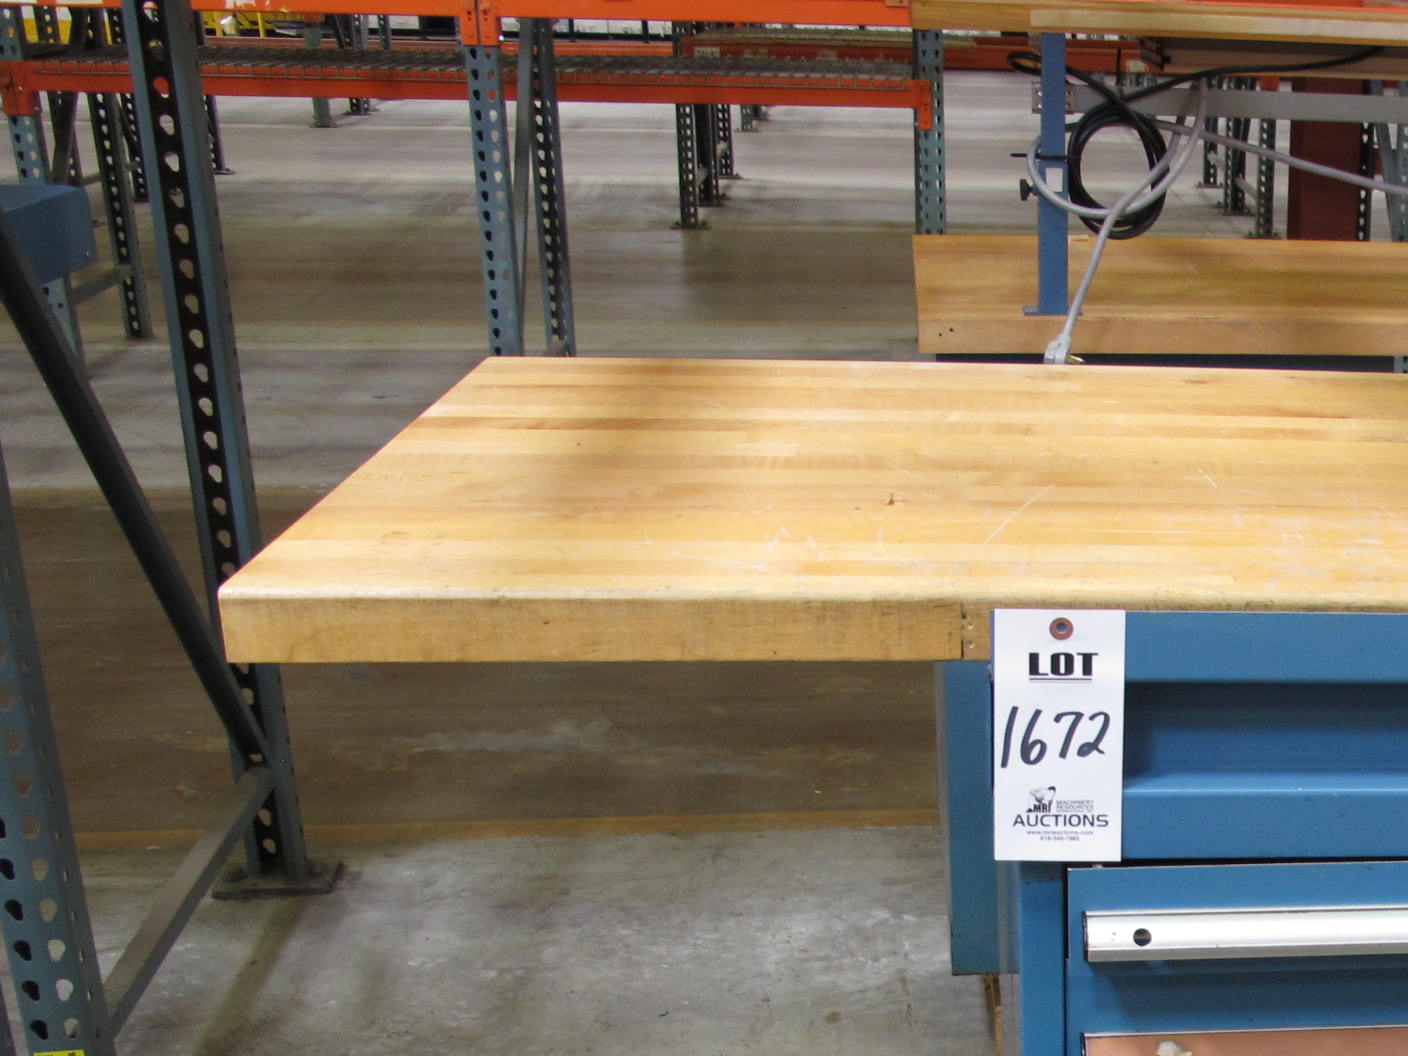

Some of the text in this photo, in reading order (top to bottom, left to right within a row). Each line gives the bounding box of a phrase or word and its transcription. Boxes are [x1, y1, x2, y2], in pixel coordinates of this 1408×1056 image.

[1029, 652, 1098, 676] LOT
[1000, 705, 1111, 769] 1672
[1012, 814, 1109, 827] AUCTIONS
